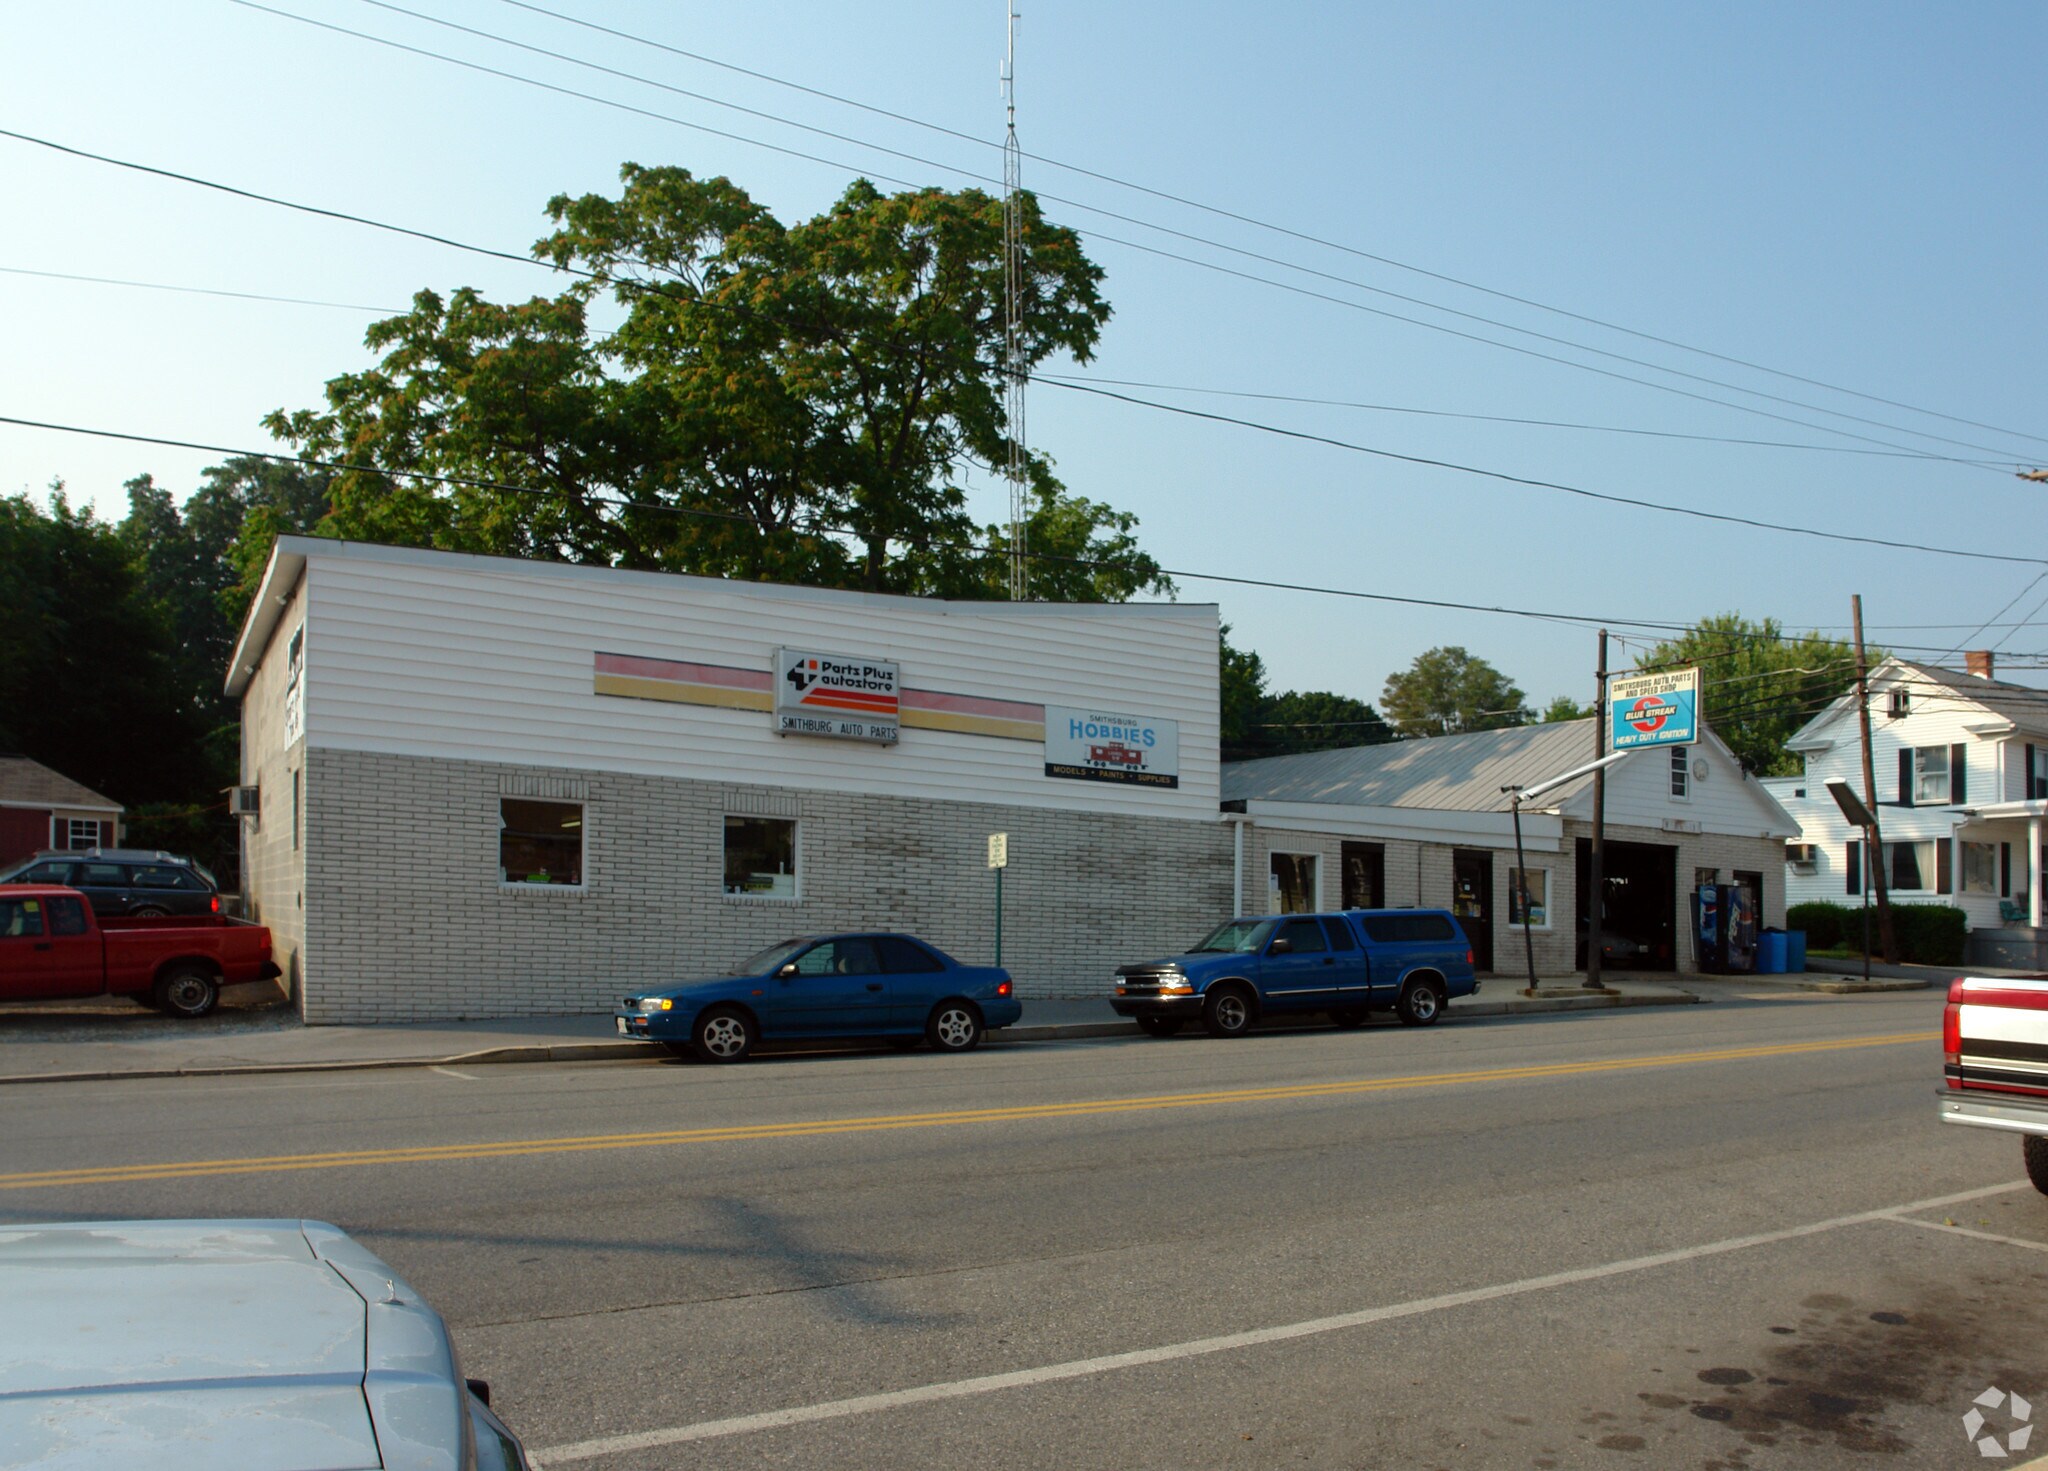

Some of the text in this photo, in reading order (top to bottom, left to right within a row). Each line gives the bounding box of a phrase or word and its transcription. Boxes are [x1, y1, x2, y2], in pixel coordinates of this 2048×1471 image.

[822, 661, 893, 680] Parts Plus
[822, 676, 892, 691] autostore
[1614, 673, 1691, 692] SMITHSBURG AUTO PARTS
[1640, 687, 1658, 695] SPEED
[1660, 684, 1676, 692] SHOP
[1090, 715, 1137, 726] SMITHSBURG
[1625, 706, 1676, 720] BLUE STREAK
[782, 717, 896, 738] SMITHBURG AUTO PARTS
[1070, 719, 1155, 746] HOBBIES
[1616, 729, 1689, 744] HEAVY DUTY IGNITION
[1054, 766, 1170, 783] MODELS PAINTS SUPPLIES
